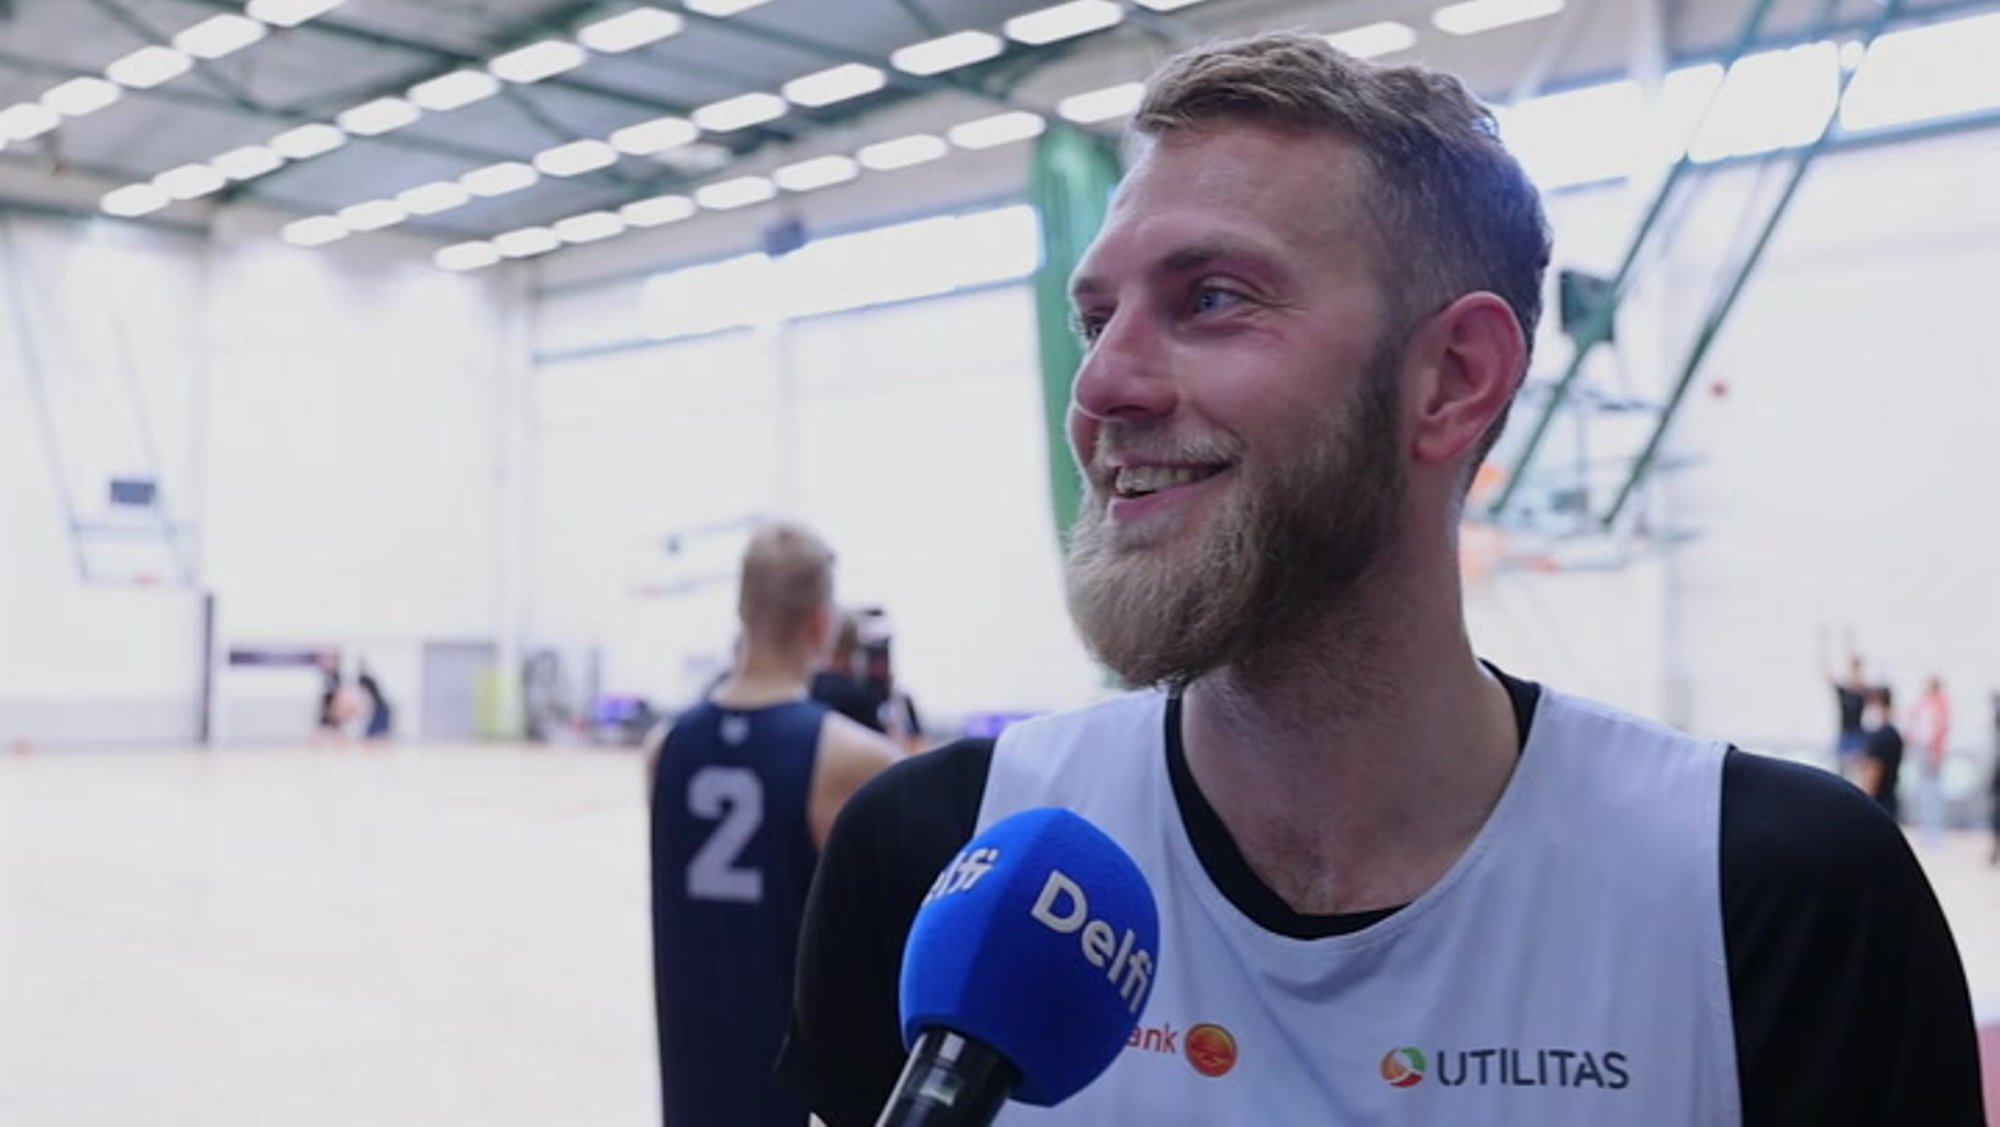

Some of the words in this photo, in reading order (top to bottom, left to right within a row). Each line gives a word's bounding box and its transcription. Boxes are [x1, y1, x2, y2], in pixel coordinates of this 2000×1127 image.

[687, 765, 763, 901] 2
[1030, 869, 1152, 1014] Delfi
[1129, 1022, 1178, 1054] ank
[1437, 1048, 1630, 1090] UTILITAS
